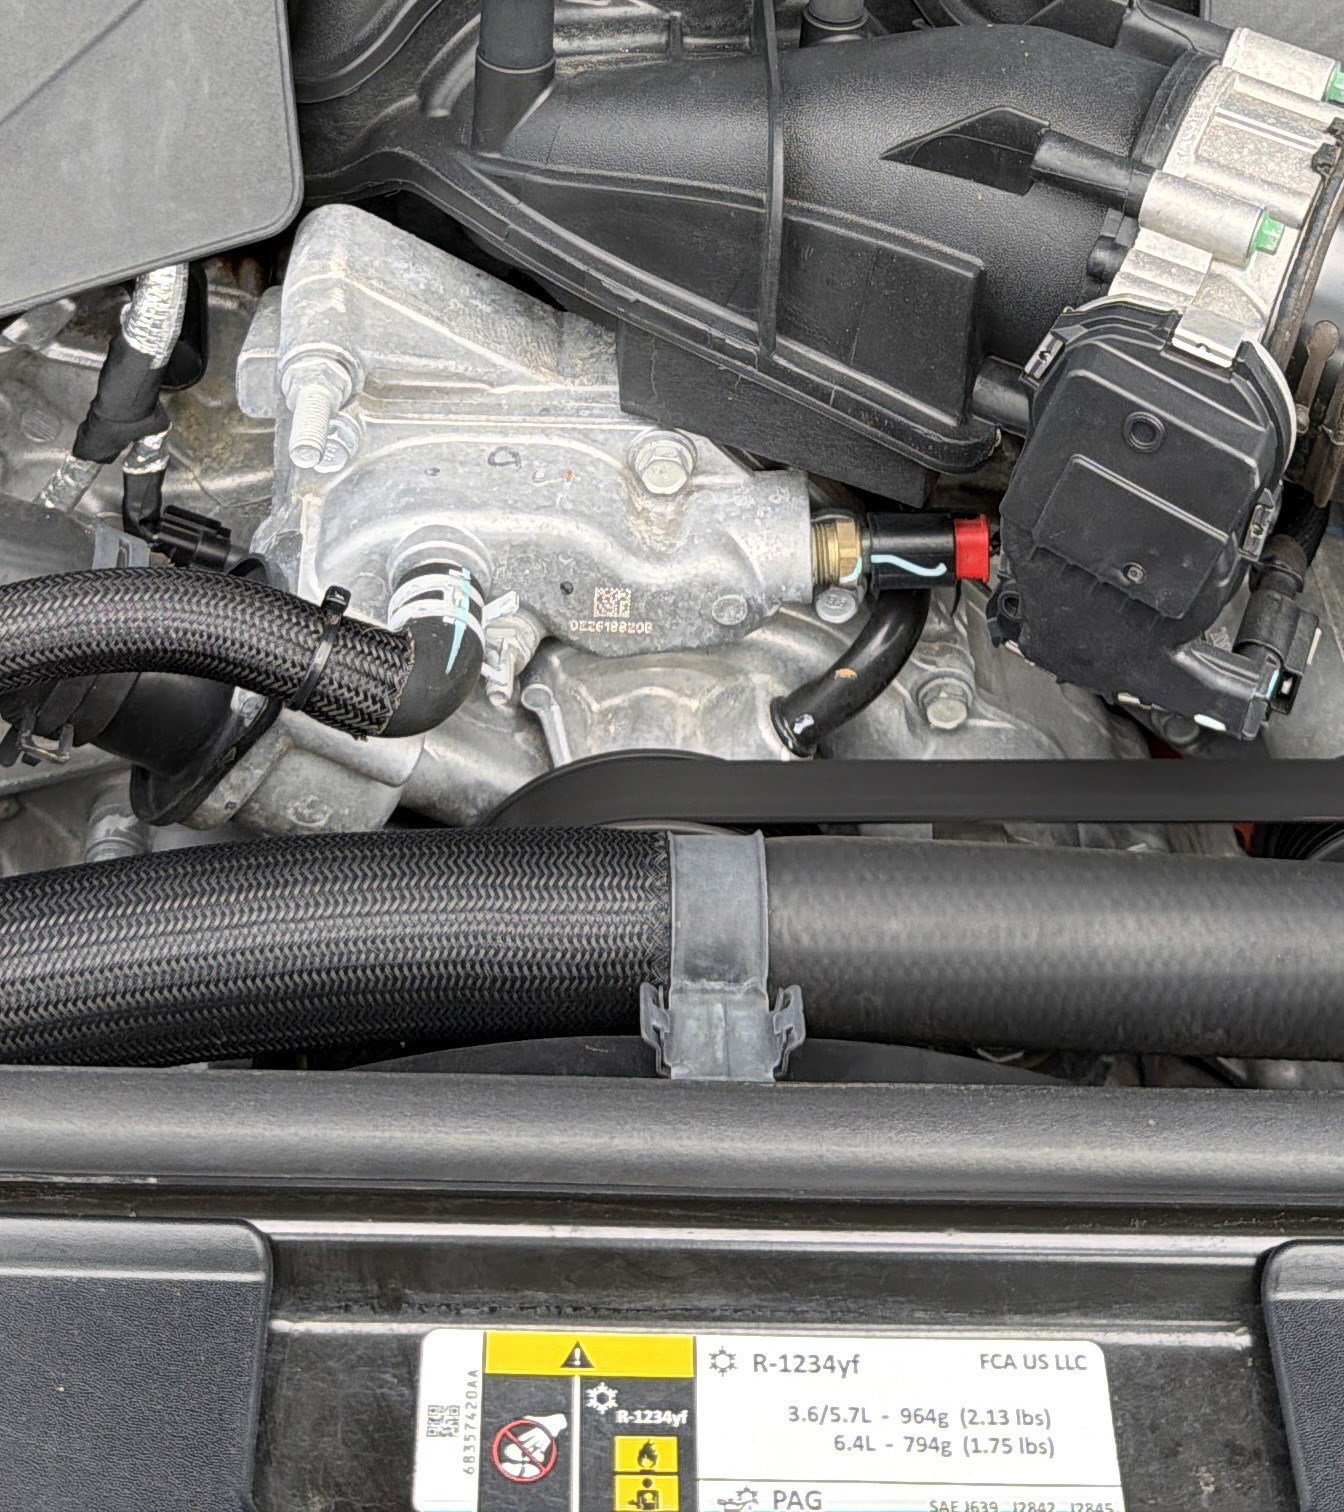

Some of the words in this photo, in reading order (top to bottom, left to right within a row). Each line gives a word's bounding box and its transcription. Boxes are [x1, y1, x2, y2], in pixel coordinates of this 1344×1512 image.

[753, 1353, 860, 1379] R-1234yf
[979, 1353, 1017, 1369] FCA
[1023, 1354, 1049, 1370] US
[1055, 1354, 1087, 1371] LLC
[462, 1369, 479, 1475] 68357420AA
[615, 1409, 689, 1429] R-1234yf
[788, 1404, 872, 1425] 3.6/5.7L
[900, 1407, 949, 1429] 964g
[960, 1407, 1010, 1427] (2.13
[1016, 1407, 1051, 1430] lbs)
[834, 1434, 876, 1452] 6.4L
[903, 1435, 953, 1458] 794g
[963, 1436, 1013, 1458] (1.75
[1019, 1437, 1055, 1458] lbs)
[773, 1489, 823, 1510] PAG
